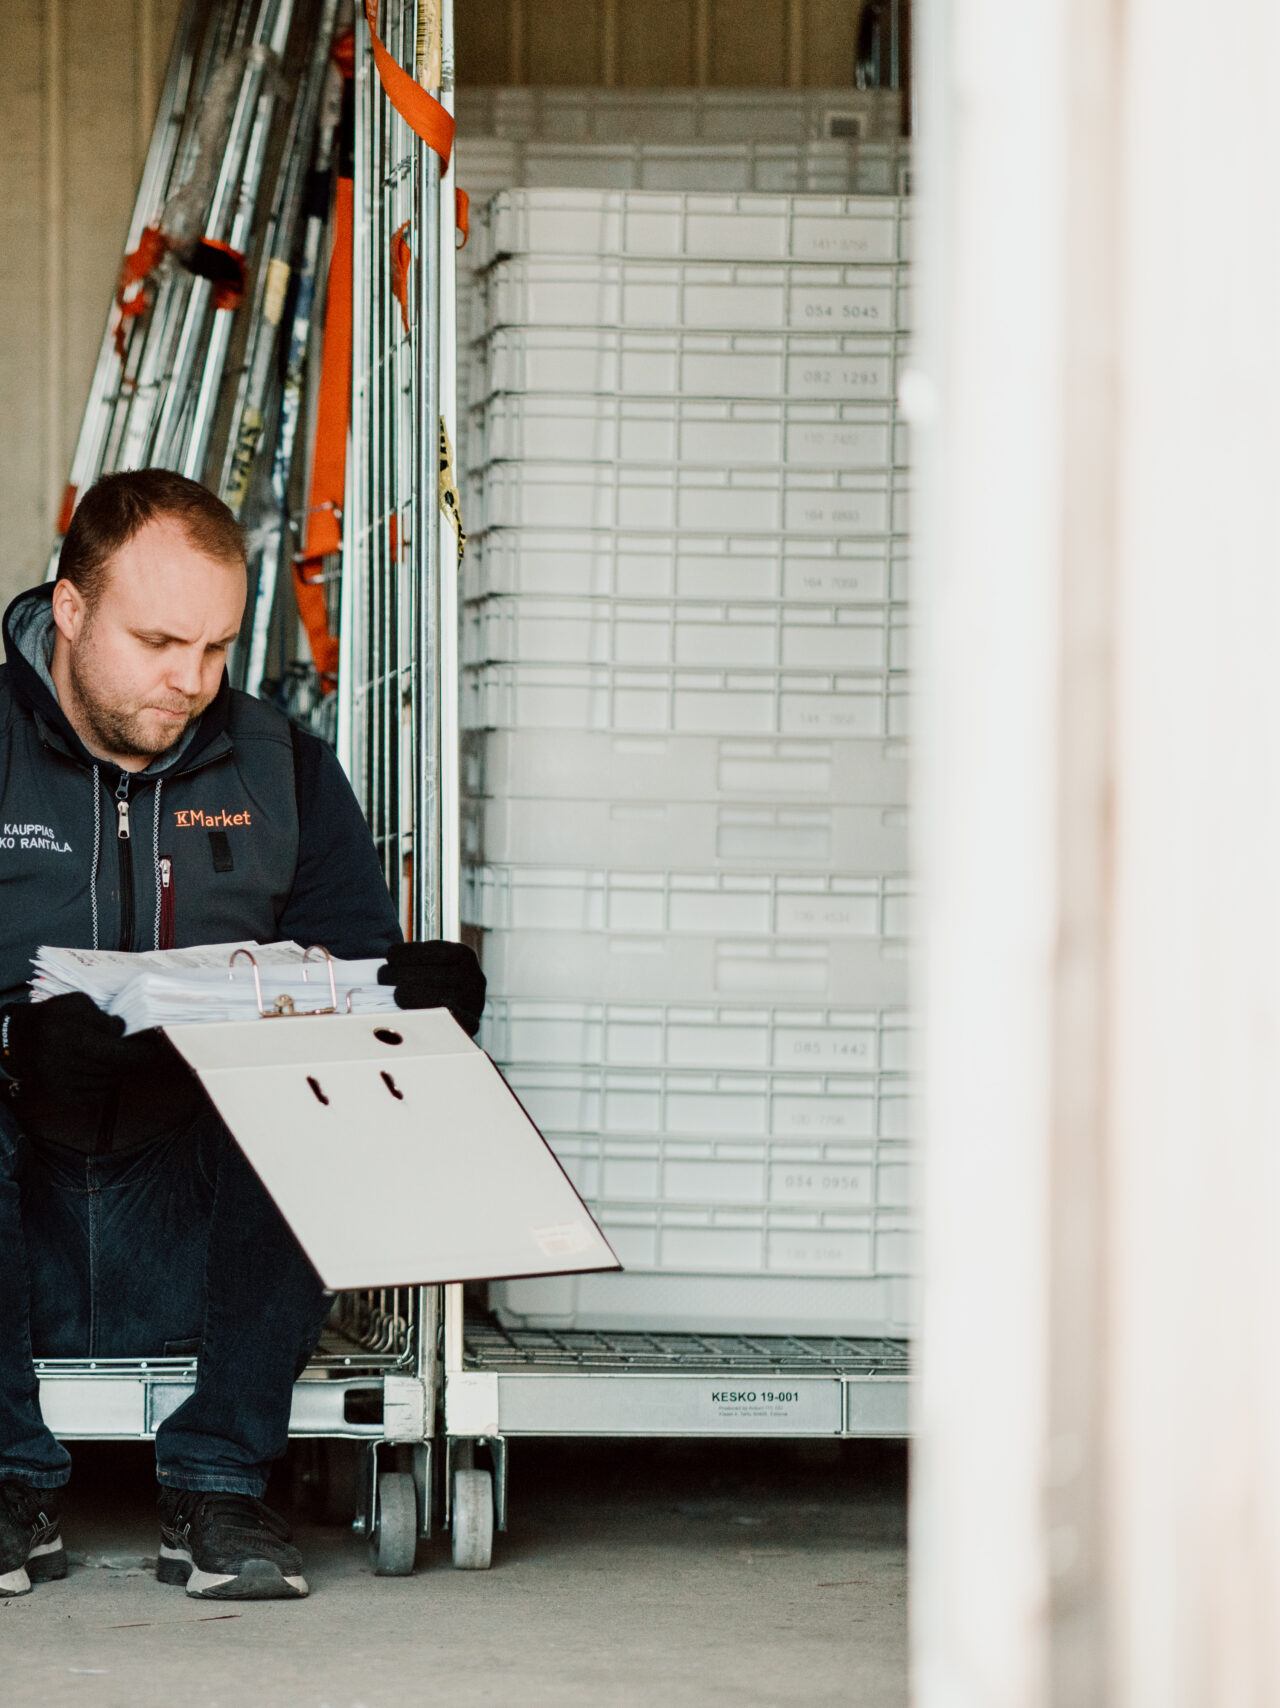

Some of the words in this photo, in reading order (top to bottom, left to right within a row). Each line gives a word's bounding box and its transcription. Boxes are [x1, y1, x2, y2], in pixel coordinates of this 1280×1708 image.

[805, 304, 832, 317] 054
[4, 822, 56, 839] KAUPPIAS
[20, 837, 73, 853] RANTALA
[712, 1392, 757, 1402] KESKO
[761, 1392, 799, 1402] 19-001
